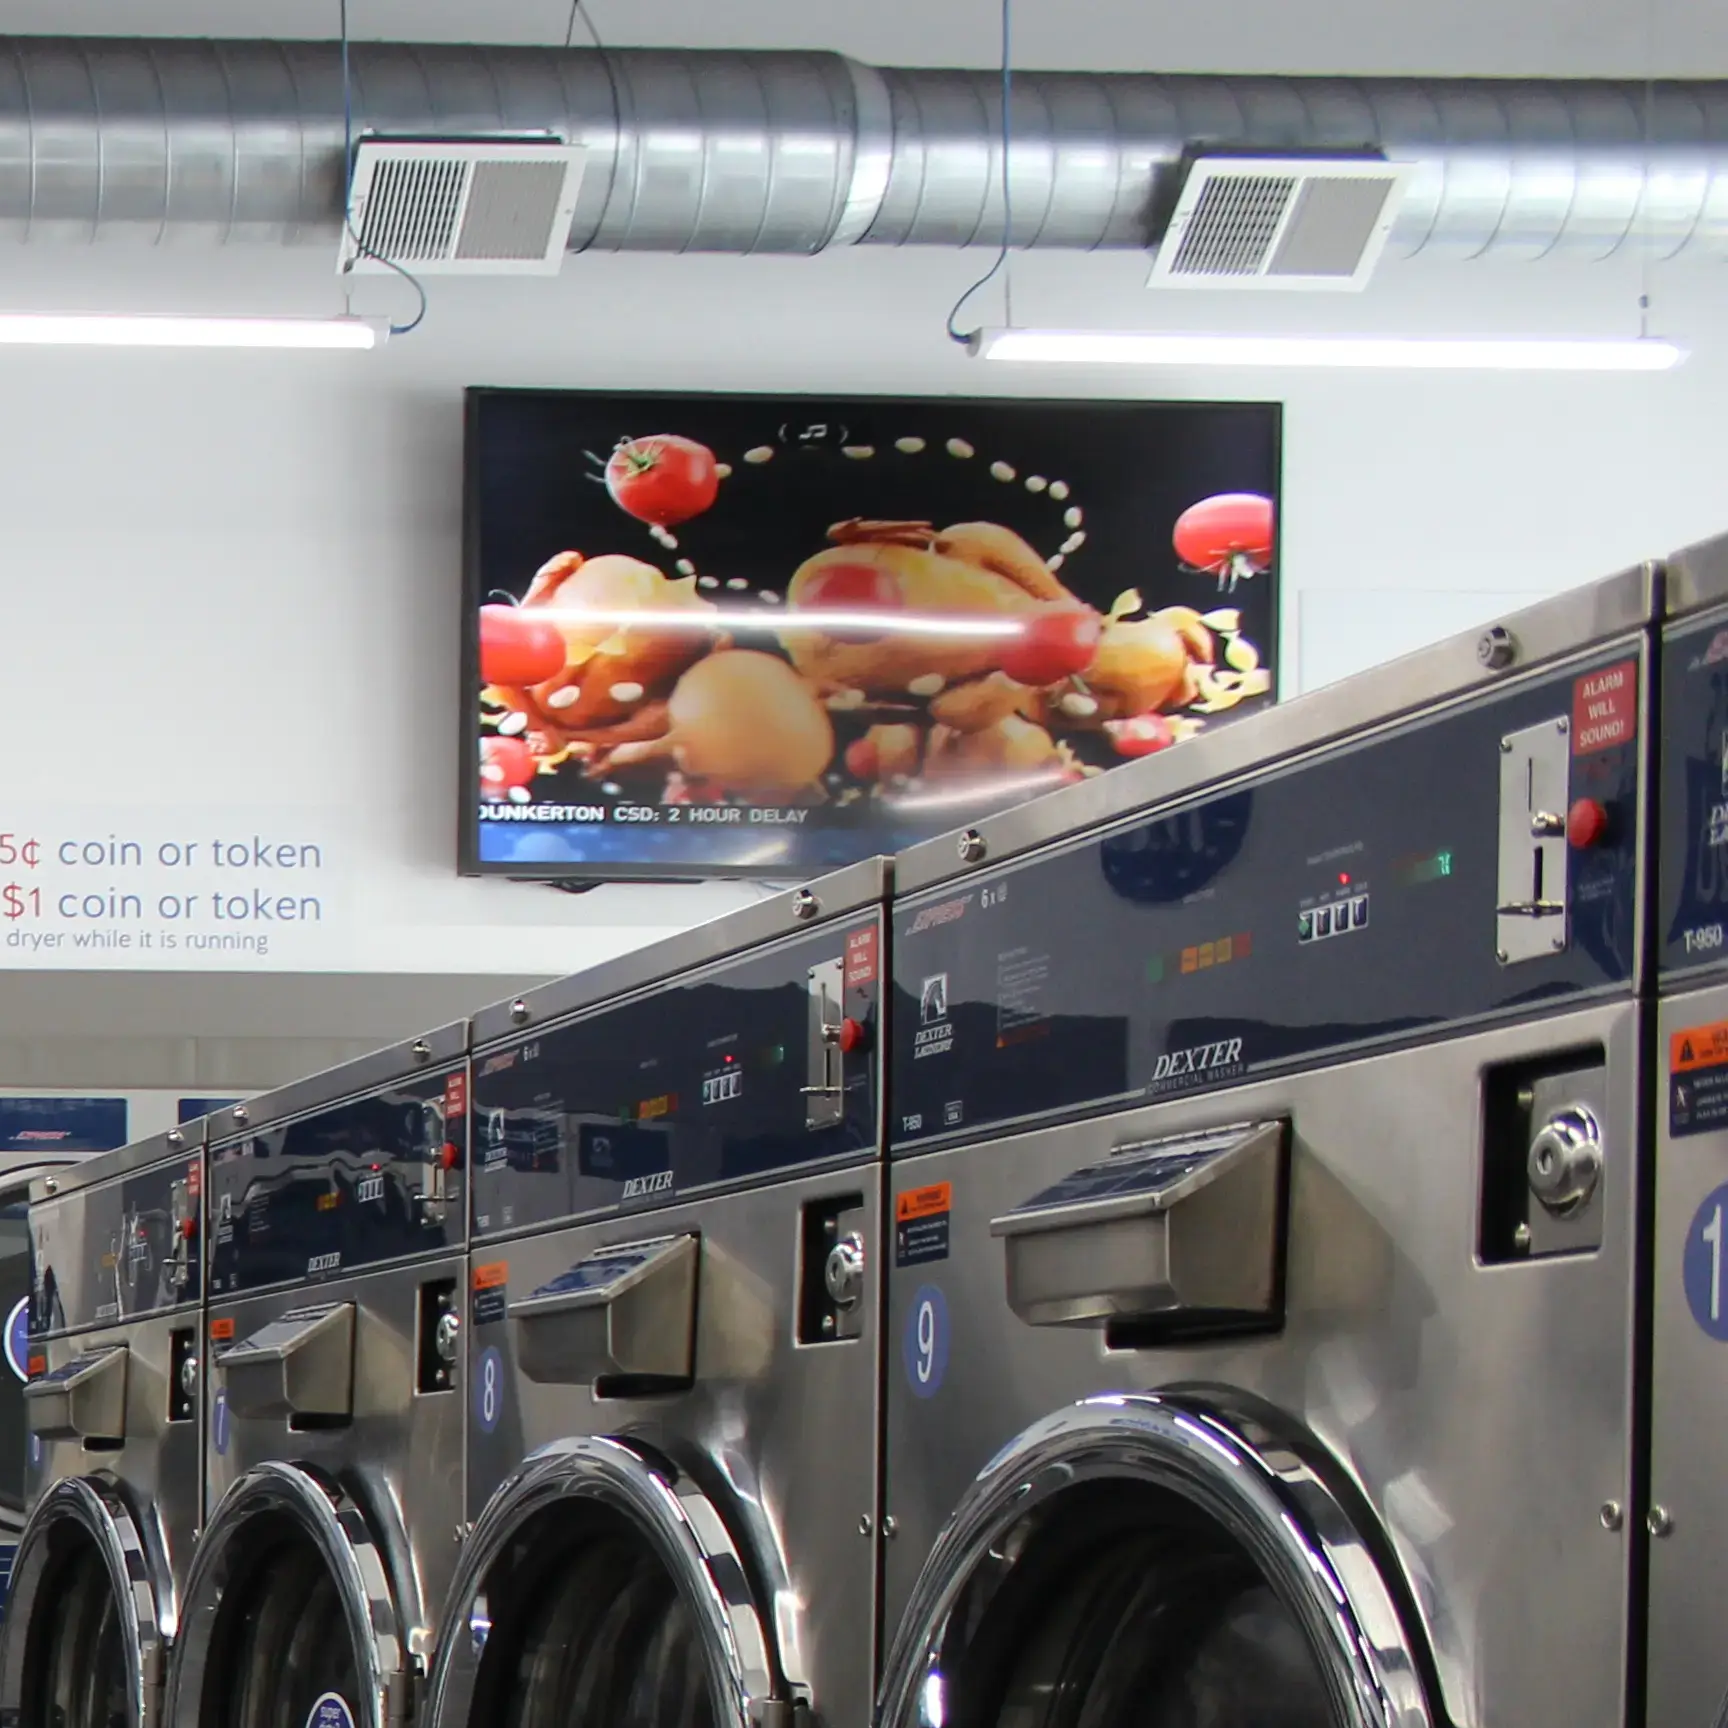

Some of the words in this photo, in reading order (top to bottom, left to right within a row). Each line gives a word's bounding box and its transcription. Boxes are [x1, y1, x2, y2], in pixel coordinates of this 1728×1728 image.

[1582, 671, 1623, 698] ALARM
[1588, 698, 1616, 719] WILL
[1580, 718, 1625, 747] SOUND!
[613, 807, 659, 822] CSD:
[668, 807, 680, 822] 2
[689, 808, 740, 822] HOUR
[749, 808, 808, 823] DELAY
[58, 834, 142, 867] coin
[158, 840, 199, 868] or
[211, 836, 322, 869] token
[3, 882, 43, 921] $1
[58, 887, 142, 920] coin
[158, 892, 199, 921] or
[211, 888, 322, 921] token
[980, 888, 989, 909] 6
[6, 927, 65, 954] dryer
[73, 929, 133, 950] while
[140, 931, 153, 949] it
[161, 931, 177, 950] is
[185, 931, 268, 955] running
[1683, 926, 1723, 953] T-950
[1151, 1037, 1242, 1081] DEXTER
[622, 1170, 674, 1200] DEXTER
[917, 1300, 934, 1383] 9
[483, 1357, 495, 1422] 8
[320, 1706, 341, 1722] super
